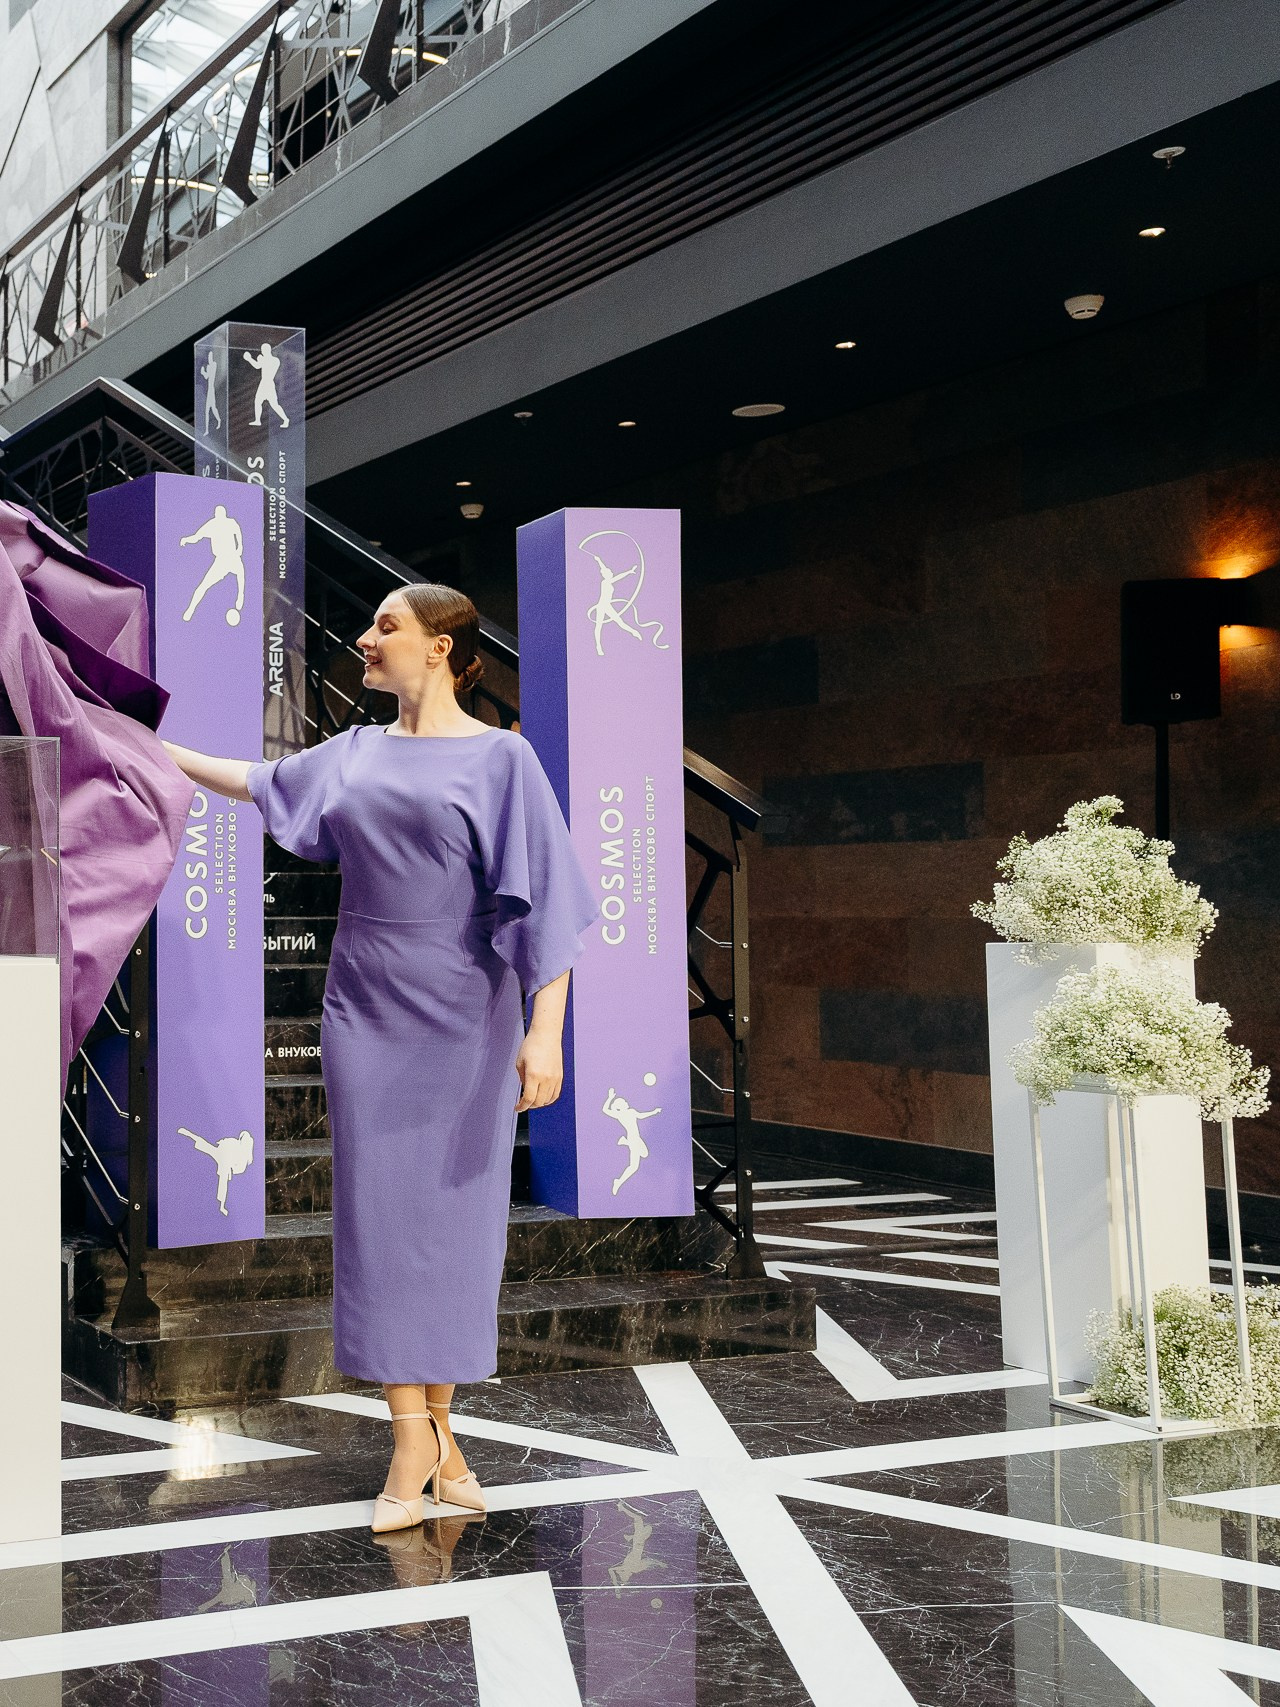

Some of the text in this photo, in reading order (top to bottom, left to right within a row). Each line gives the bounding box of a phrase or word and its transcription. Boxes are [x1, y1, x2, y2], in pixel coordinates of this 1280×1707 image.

[269, 487, 277, 541] SELECTION
[279, 451, 287, 579] МОСКВА ВНУКОВО СПОРТ
[268, 622, 284, 697] ARENA
[1170, 692, 1181, 700] LD
[185, 791, 208, 939] COSMO
[215, 813, 224, 894] SELECTION
[228, 812, 237, 882] ВНУКОВО
[599, 786, 626, 945] COSMOS
[632, 827, 642, 903] SELECTION
[645, 775, 657, 955] МОСКВА ВНУКОВО СПОРТ
[228, 888, 237, 949] МОСКВА
[263, 932, 316, 951] БЫТИЙ
[277, 1046, 322, 1058] ВНУКОВ
